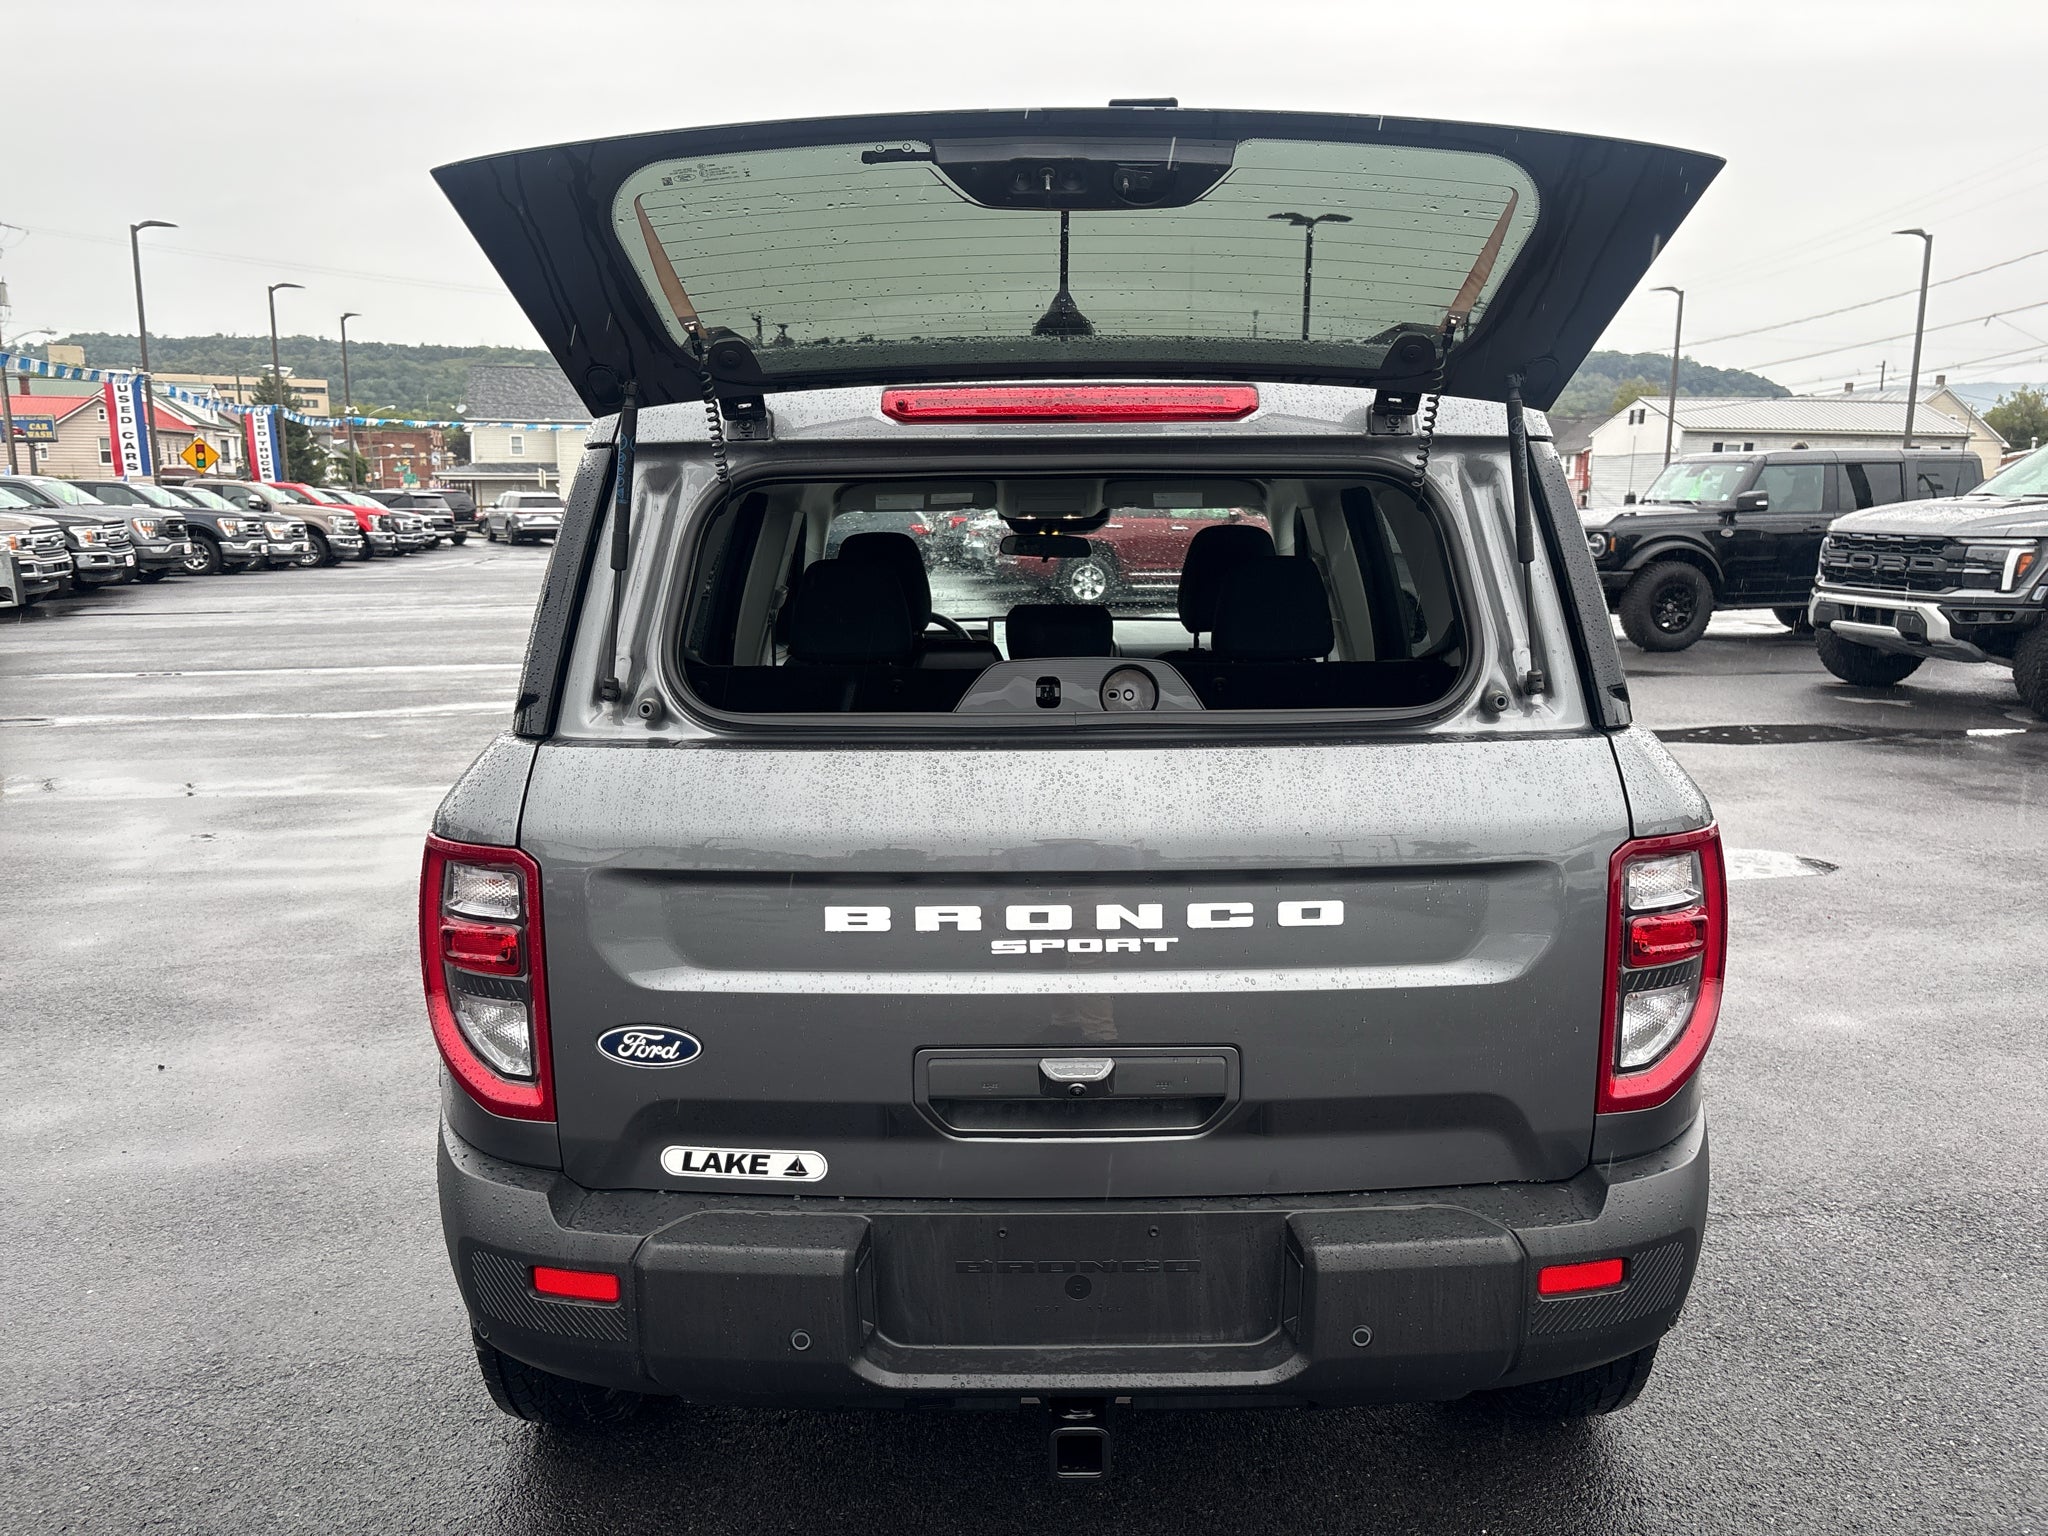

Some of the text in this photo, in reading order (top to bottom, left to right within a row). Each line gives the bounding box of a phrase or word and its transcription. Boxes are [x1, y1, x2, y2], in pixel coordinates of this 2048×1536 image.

[116, 384, 138, 471] USED CARS
[255, 409, 272, 479] USED TRUCKS
[1825, 551, 1948, 572] FORD
[824, 901, 1344, 932] BRONCO
[990, 937, 1179, 954] SPORT
[617, 1032, 680, 1059] Ford
[681, 1151, 771, 1175] LAKE
[955, 1259, 1200, 1274] BRONCO
